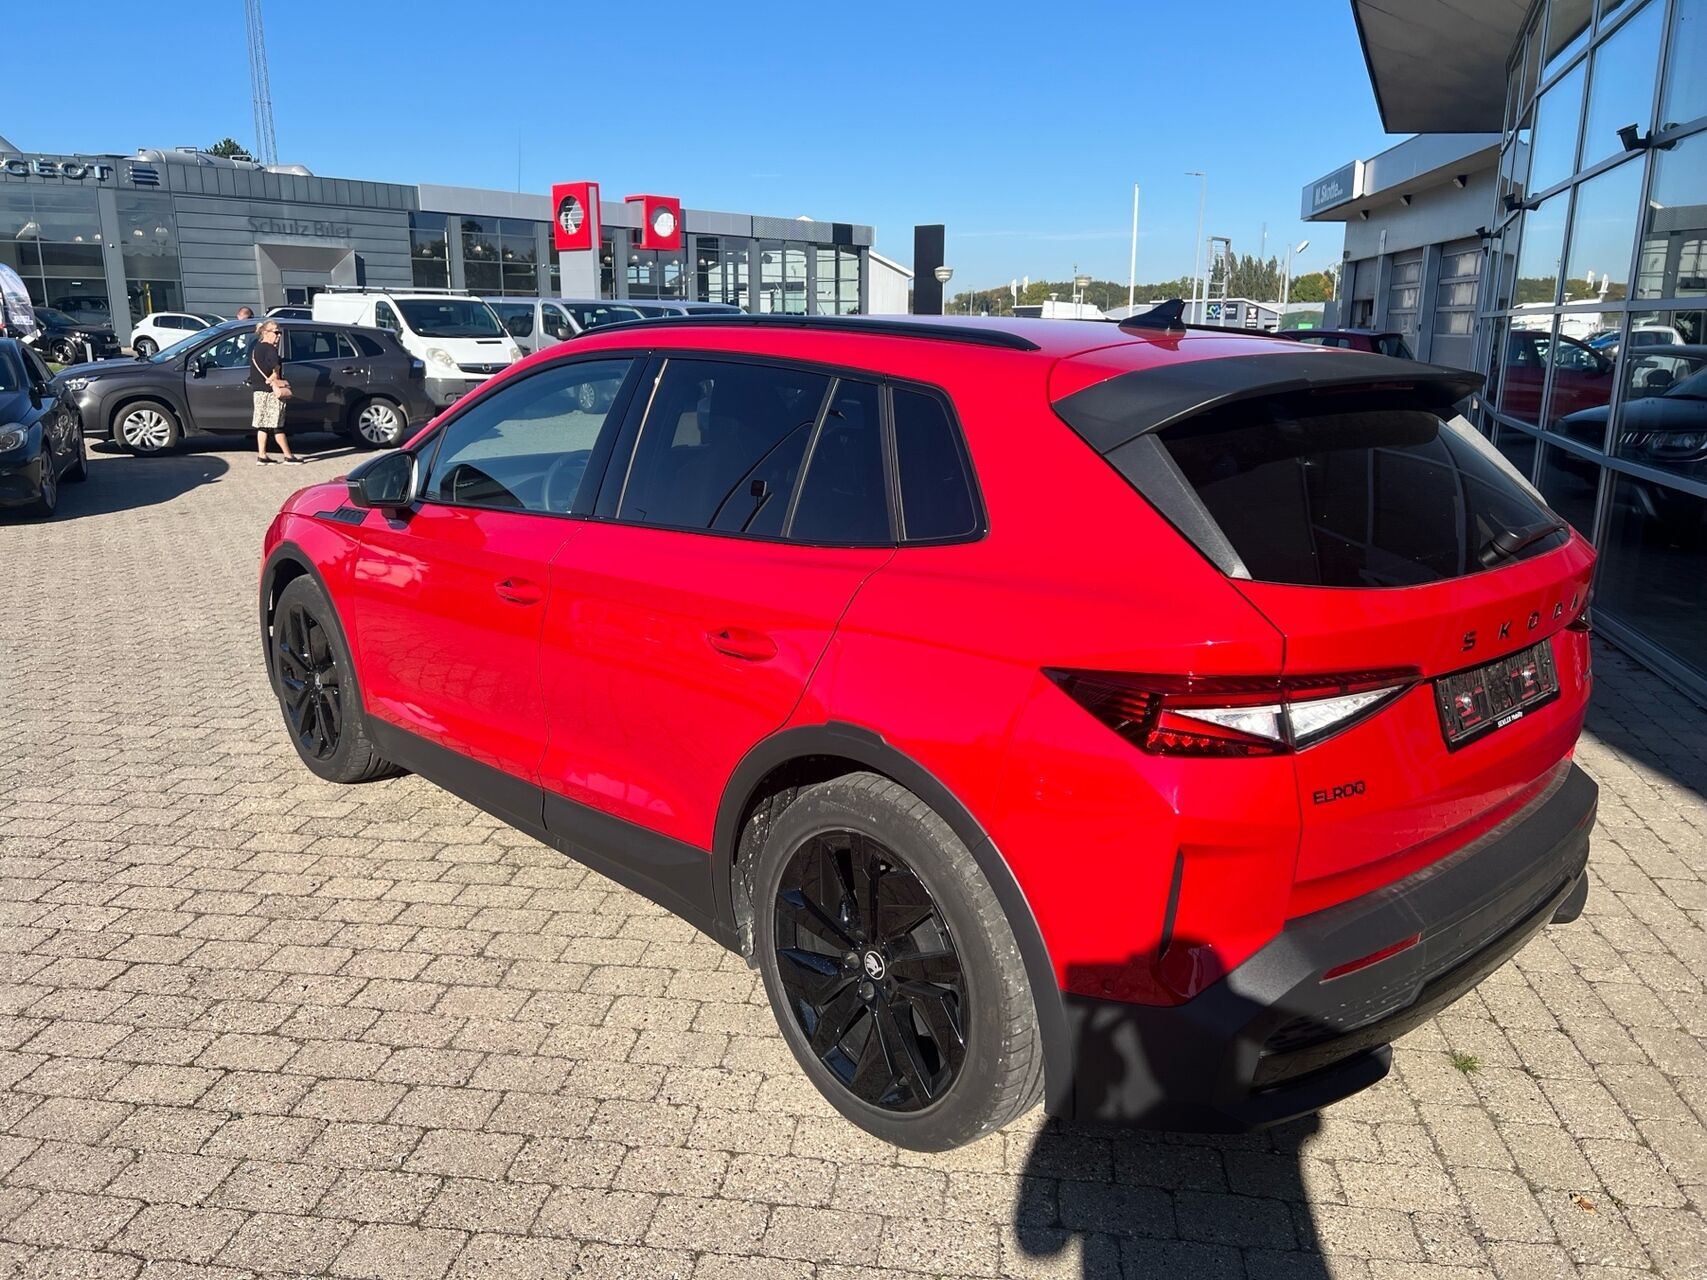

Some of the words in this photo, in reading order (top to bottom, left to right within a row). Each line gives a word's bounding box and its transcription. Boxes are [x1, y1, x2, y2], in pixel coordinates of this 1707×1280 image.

[0, 156, 113, 180] GEOT
[248, 216, 308, 236] Schulz
[1313, 780, 1366, 805] ELROQ
